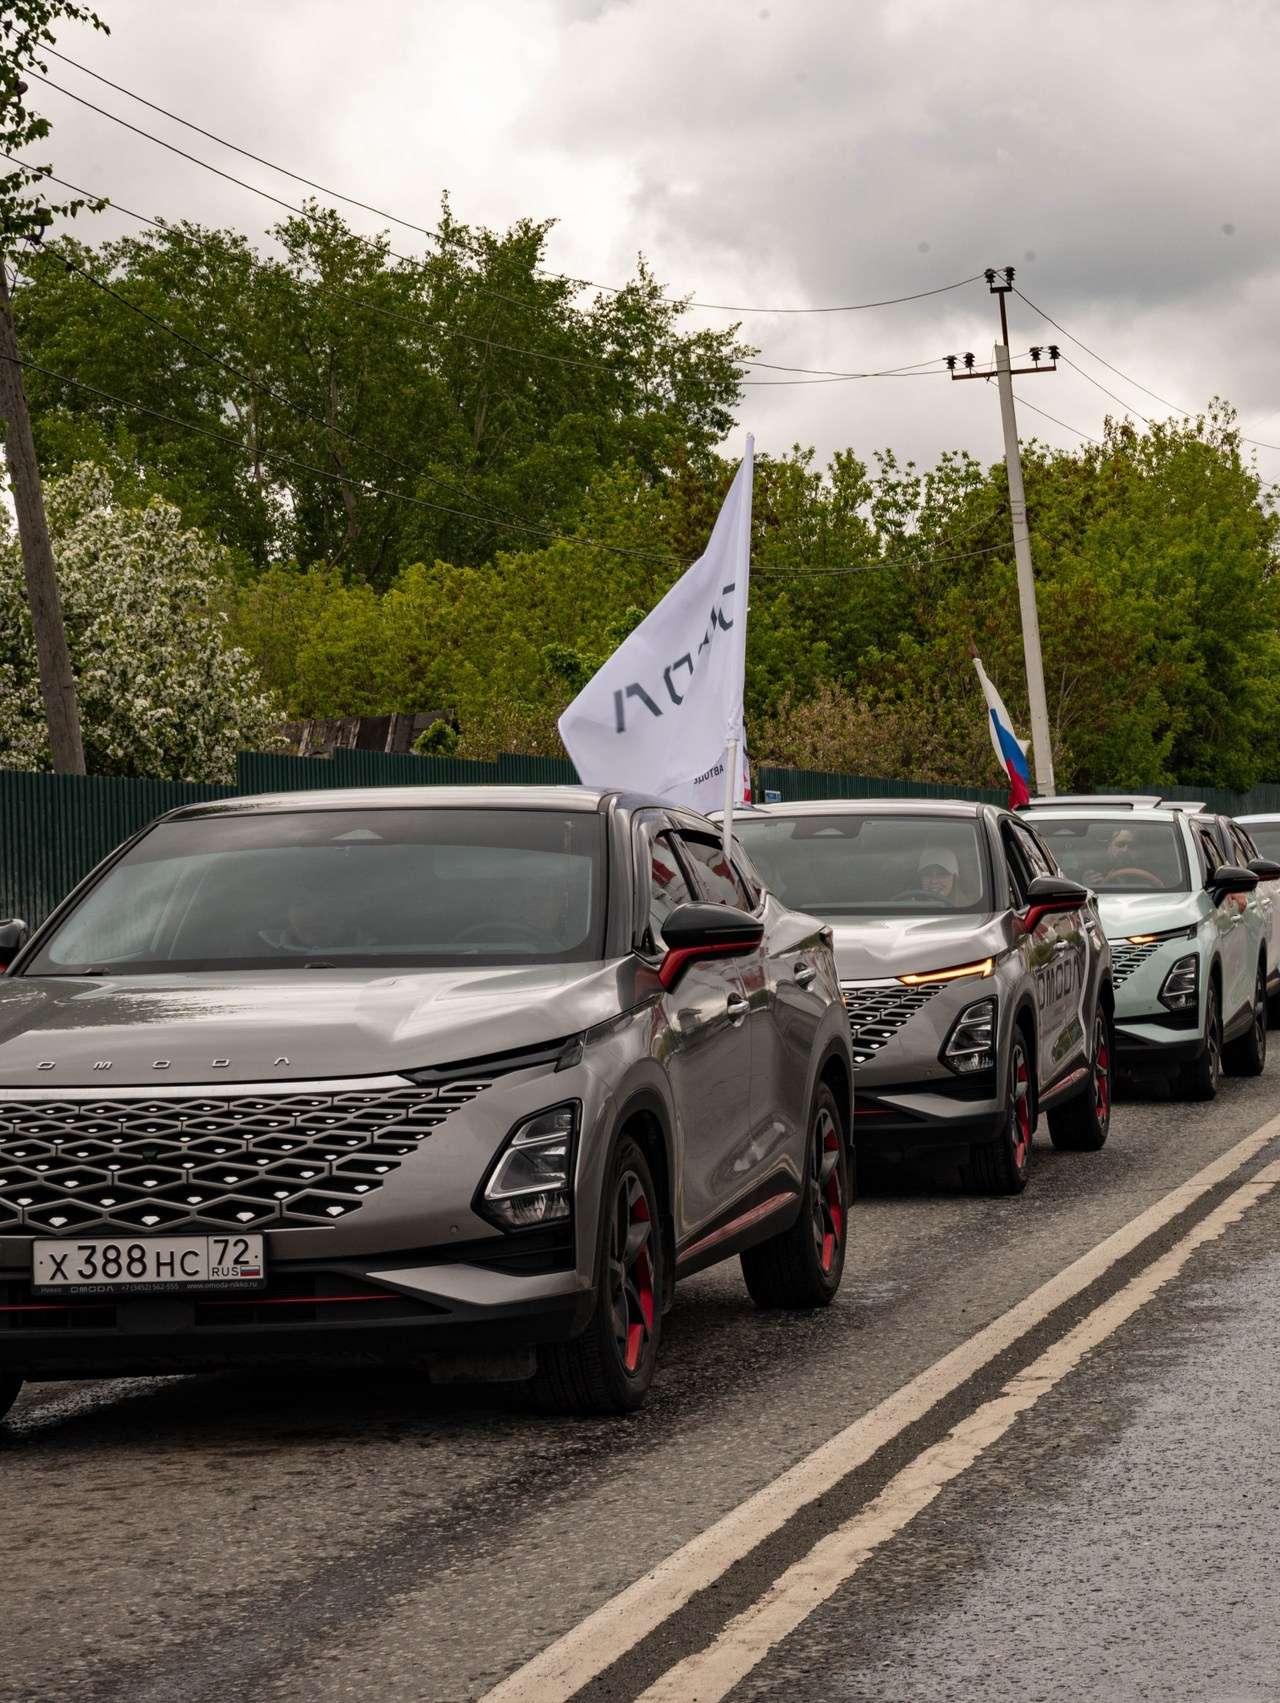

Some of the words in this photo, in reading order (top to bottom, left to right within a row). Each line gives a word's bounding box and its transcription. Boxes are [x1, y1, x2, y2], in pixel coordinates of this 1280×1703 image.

[36, 1056, 290, 1070] OMODA
[213, 1238, 250, 1266] 72
[211, 1266, 240, 1278] RUS
[70, 1285, 114, 1294] OMODA
